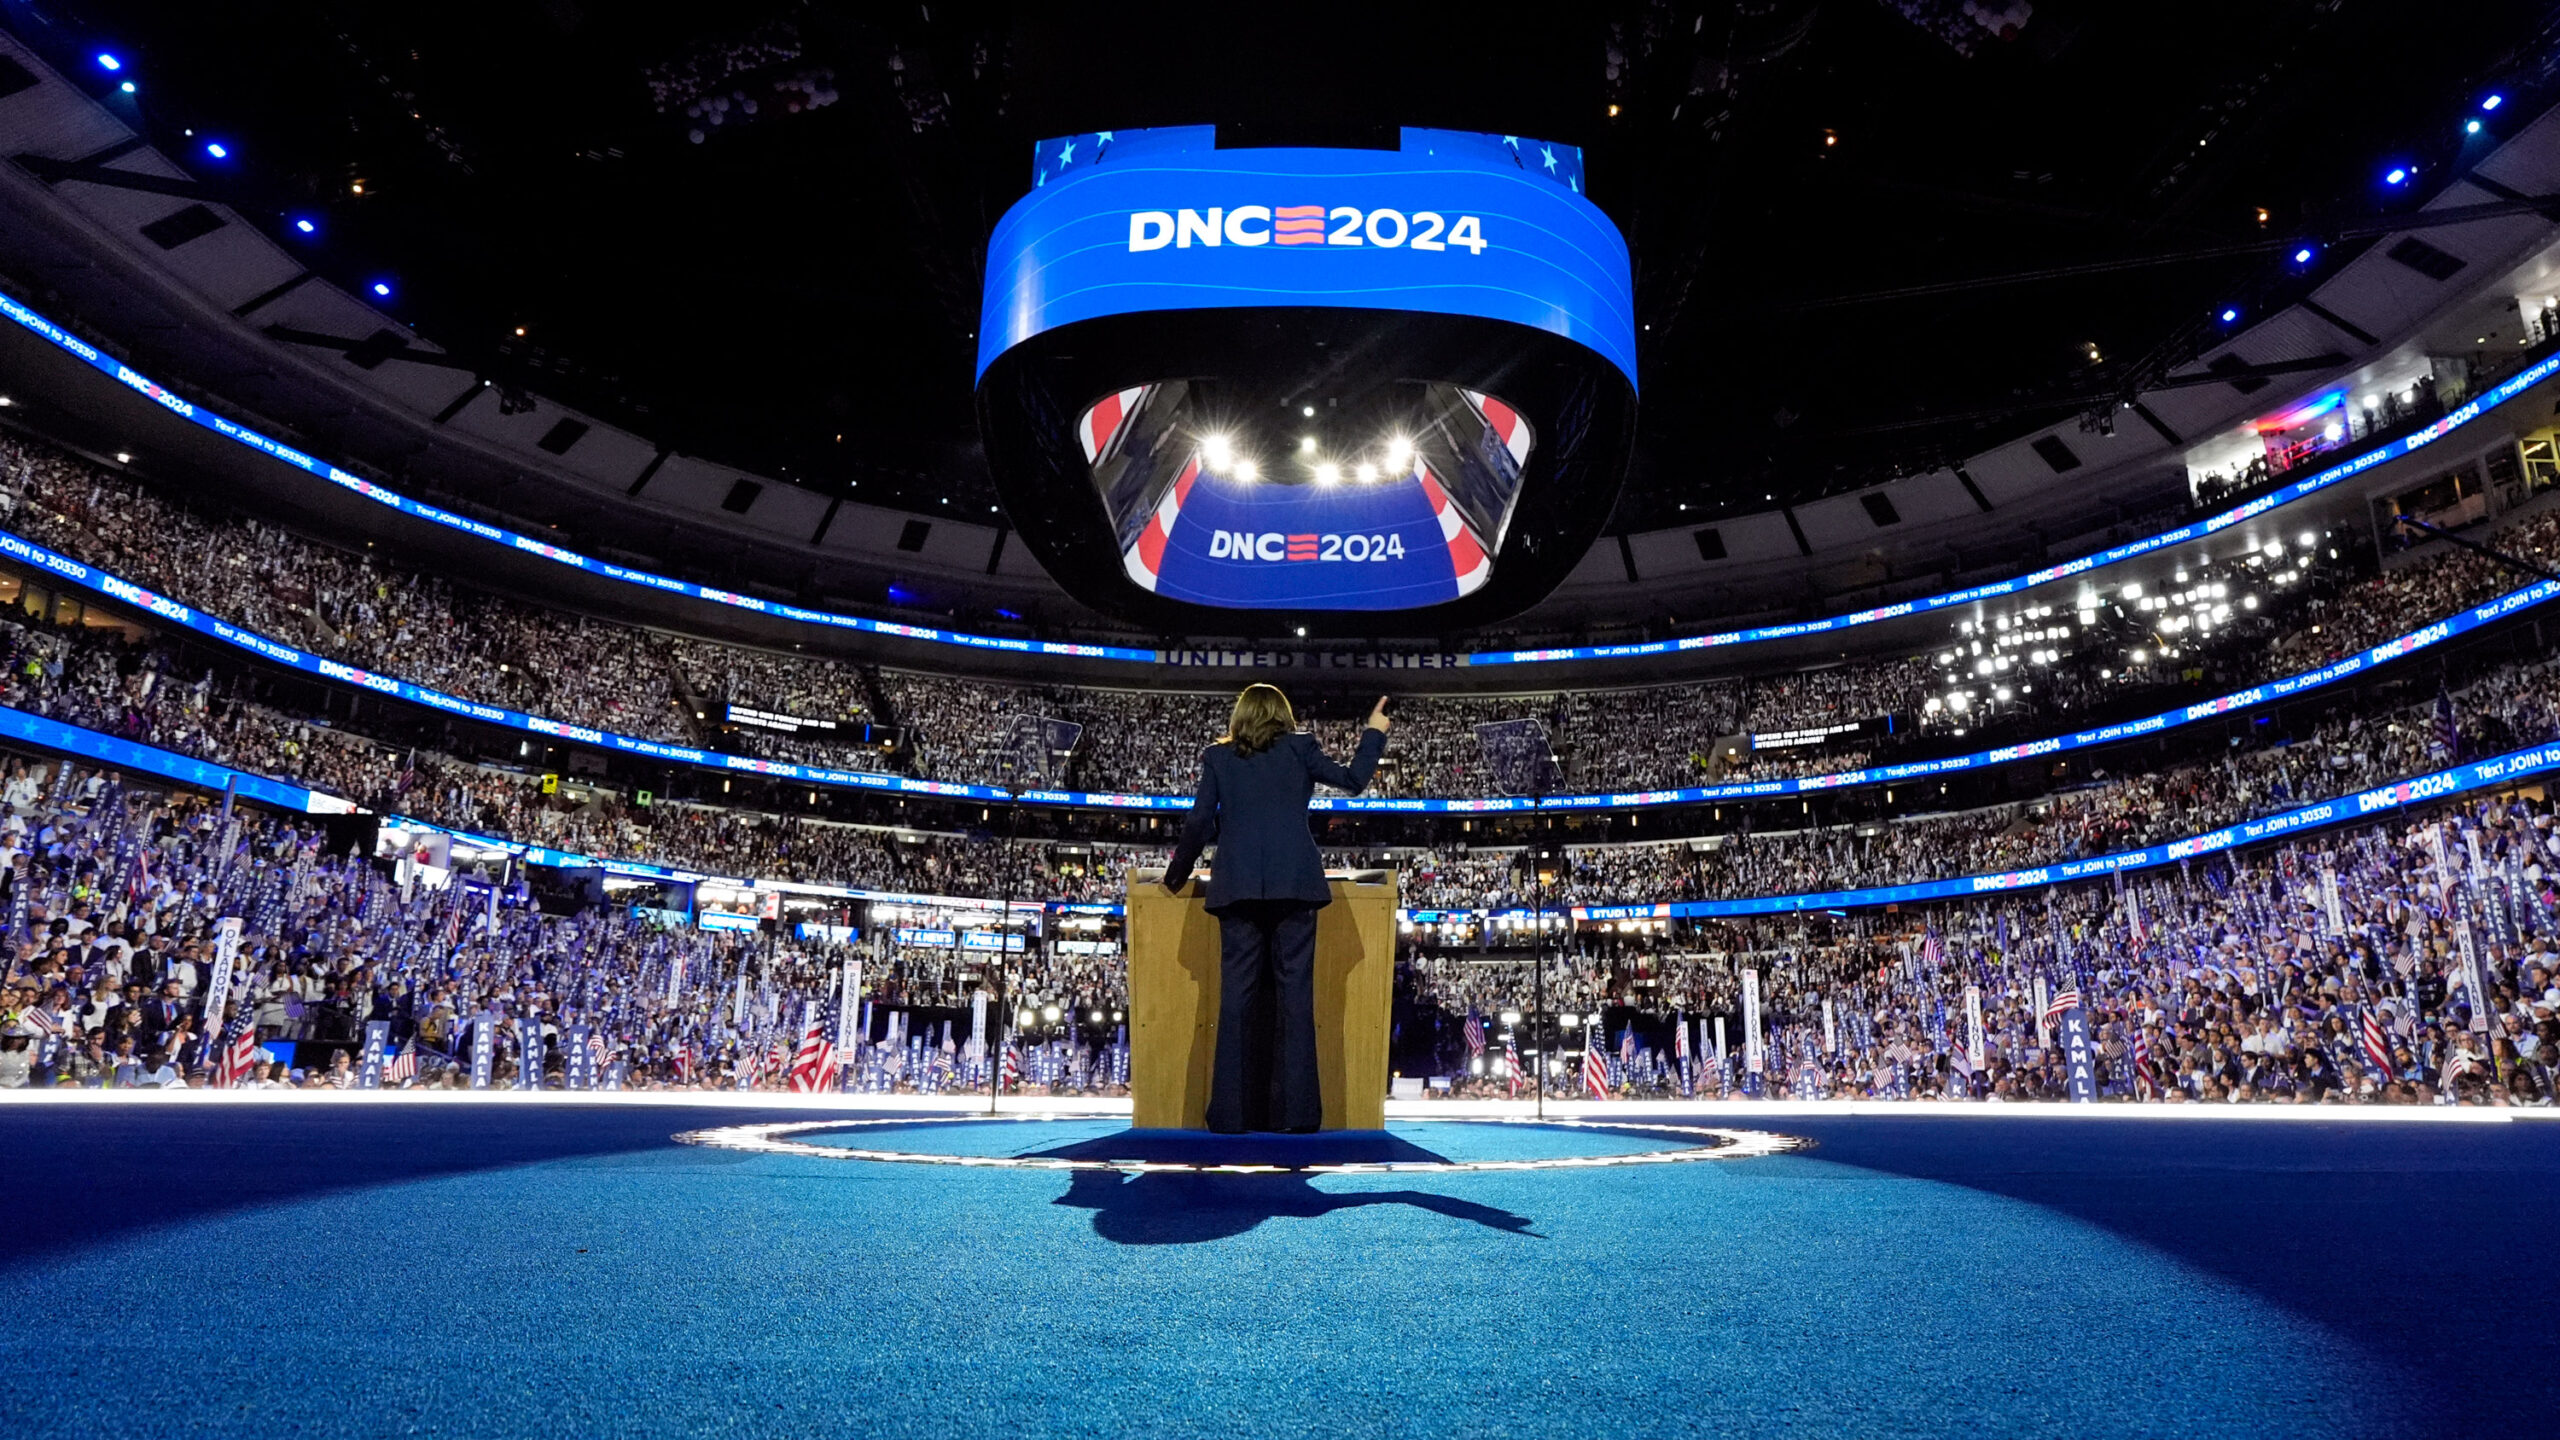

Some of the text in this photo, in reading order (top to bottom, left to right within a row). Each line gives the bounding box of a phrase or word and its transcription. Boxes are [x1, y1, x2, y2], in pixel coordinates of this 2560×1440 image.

[51, 328, 64, 341] to
[31, 550, 46, 563] to
[47, 554, 87, 579] 30330
[2475, 604, 2499, 621] Text
[2500, 590, 2529, 613] JOIN
[2530, 586, 2543, 600] to
[1165, 649, 1458, 669] UNITED CENTER
[2475, 761, 2505, 780] Text
[2507, 751, 2543, 773] JOIN
[2244, 805, 2333, 838] Text JOIN to 30330
[213, 928, 237, 1005] OKLAHOMA
[2460, 934, 2482, 1016] MARYLAND
[364, 1029, 383, 1087] KAMAL
[475, 1021, 490, 1088] KAMALA
[569, 1033, 583, 1089] KAMAL
[2346, 1010, 2373, 1068] KAMALA
